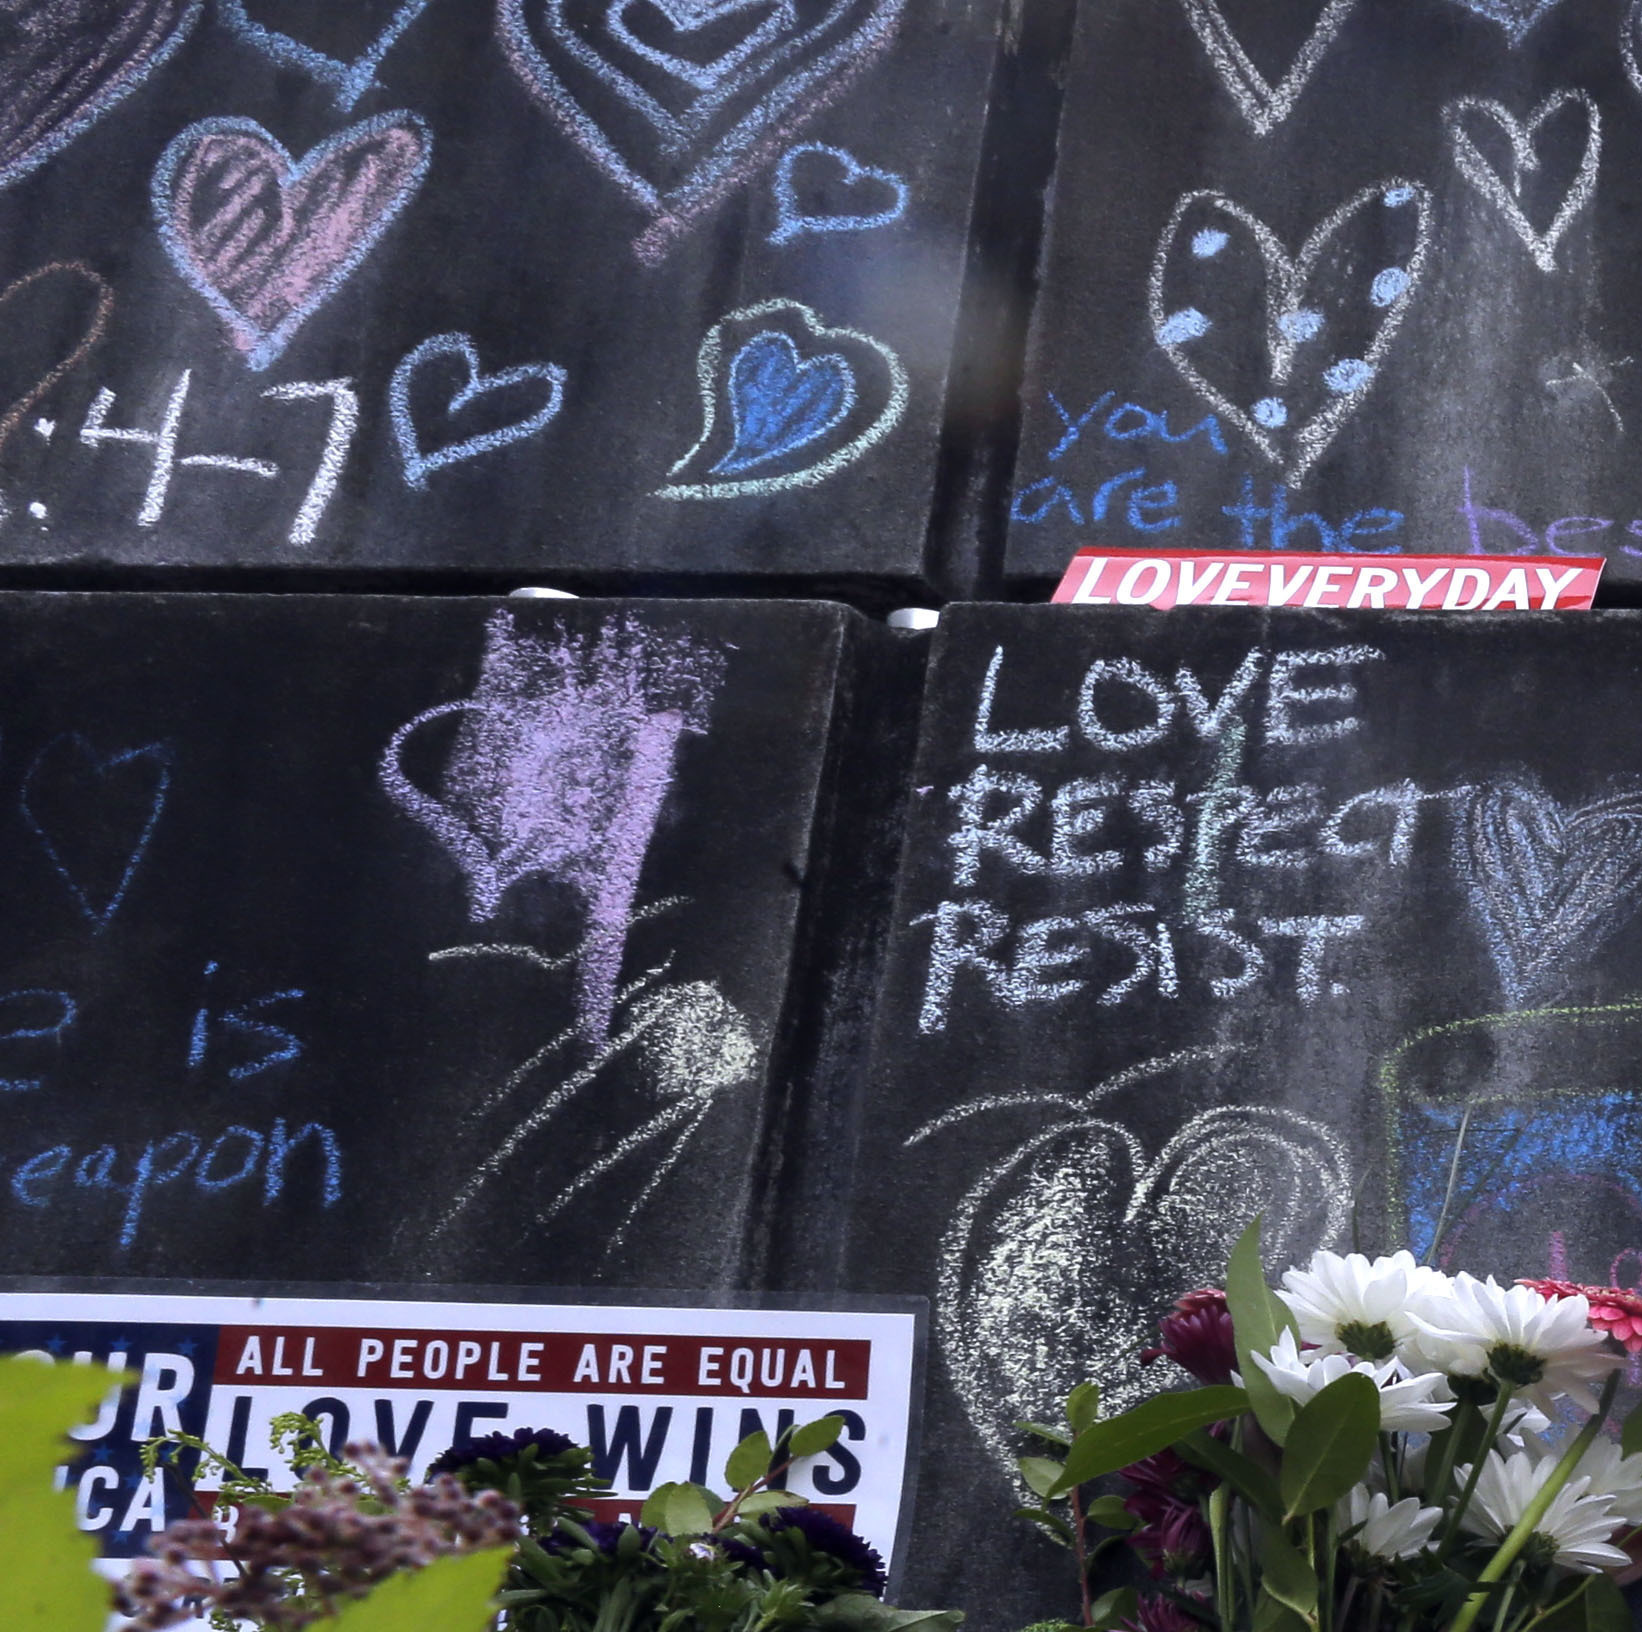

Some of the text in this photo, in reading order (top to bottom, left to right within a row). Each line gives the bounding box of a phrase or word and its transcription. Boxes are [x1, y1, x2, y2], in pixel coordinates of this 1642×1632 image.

[1009, 467, 1181, 534] are
[1222, 478, 1403, 556] the
[1076, 555, 1585, 611] LOVEVERYDAY
[973, 645, 1387, 753] LOVE
[947, 763, 1477, 888] RESPECT
[188, 960, 307, 1083] is
[236, 1334, 848, 1392] ALL PEOPLE ARE EQUAL
[586, 1402, 869, 1497] WINS
